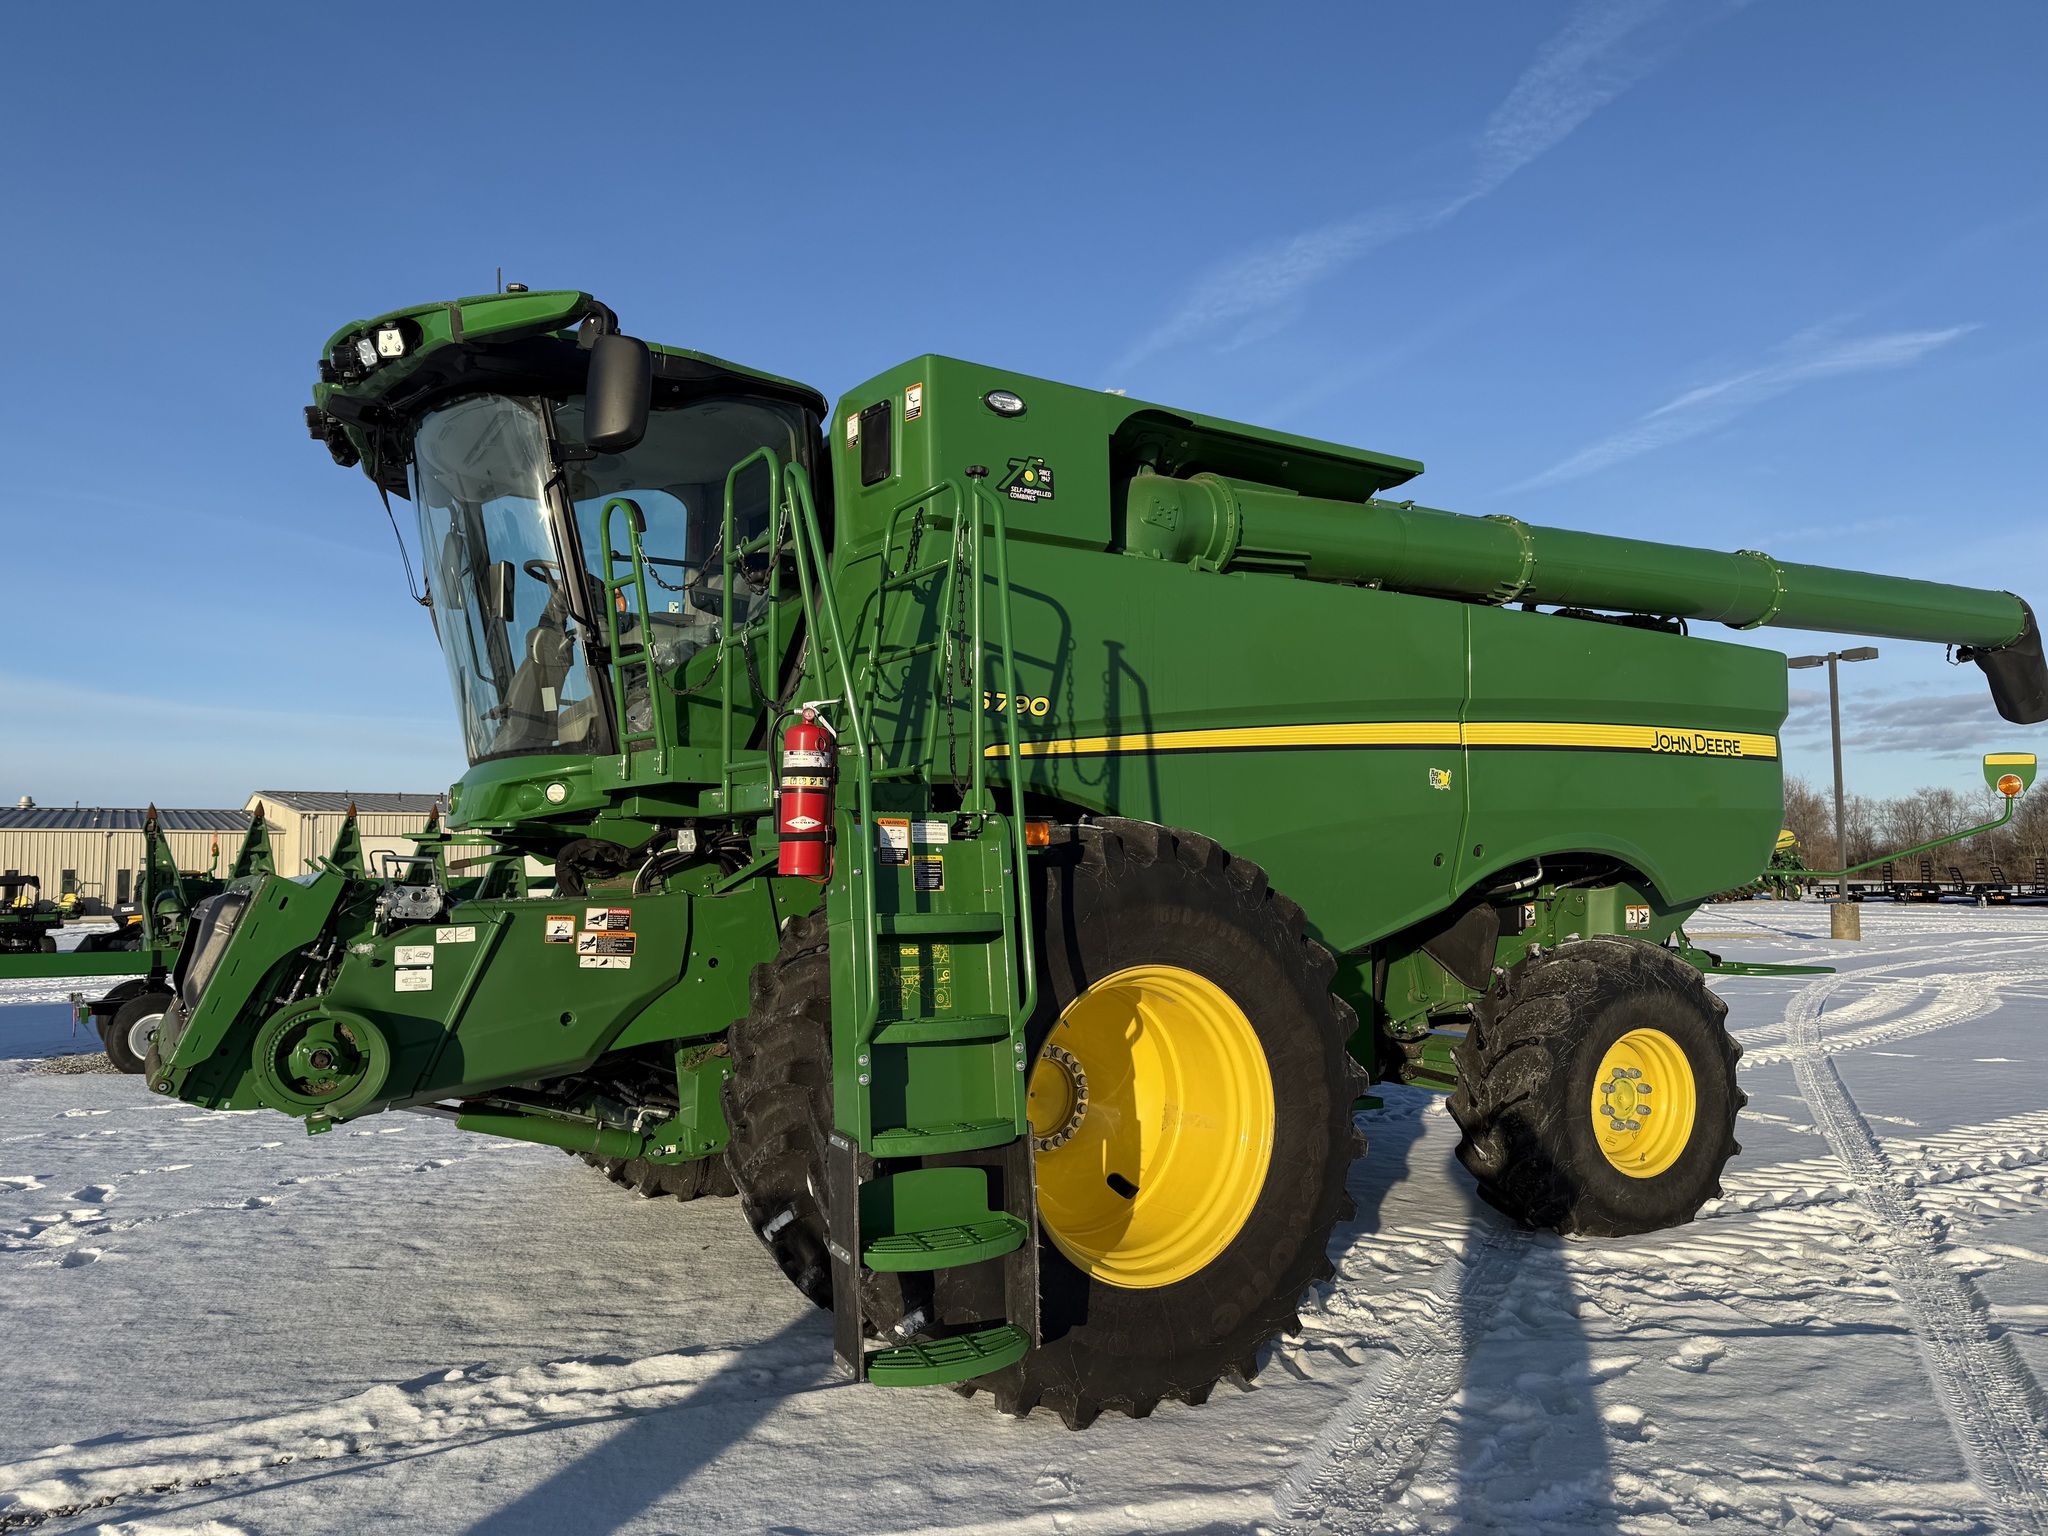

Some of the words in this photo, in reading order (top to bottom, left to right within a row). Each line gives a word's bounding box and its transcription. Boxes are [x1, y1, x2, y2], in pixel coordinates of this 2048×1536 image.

[999, 458, 1043, 489] 75
[1038, 469, 1051, 477] SINCE
[1009, 492, 1036, 501] COMBINES
[1010, 486, 1052, 498] SELF-PROPELLED
[1651, 730, 1692, 751] JOHN
[1694, 734, 1742, 754] DEERE
[1431, 777, 1442, 785] Pro
